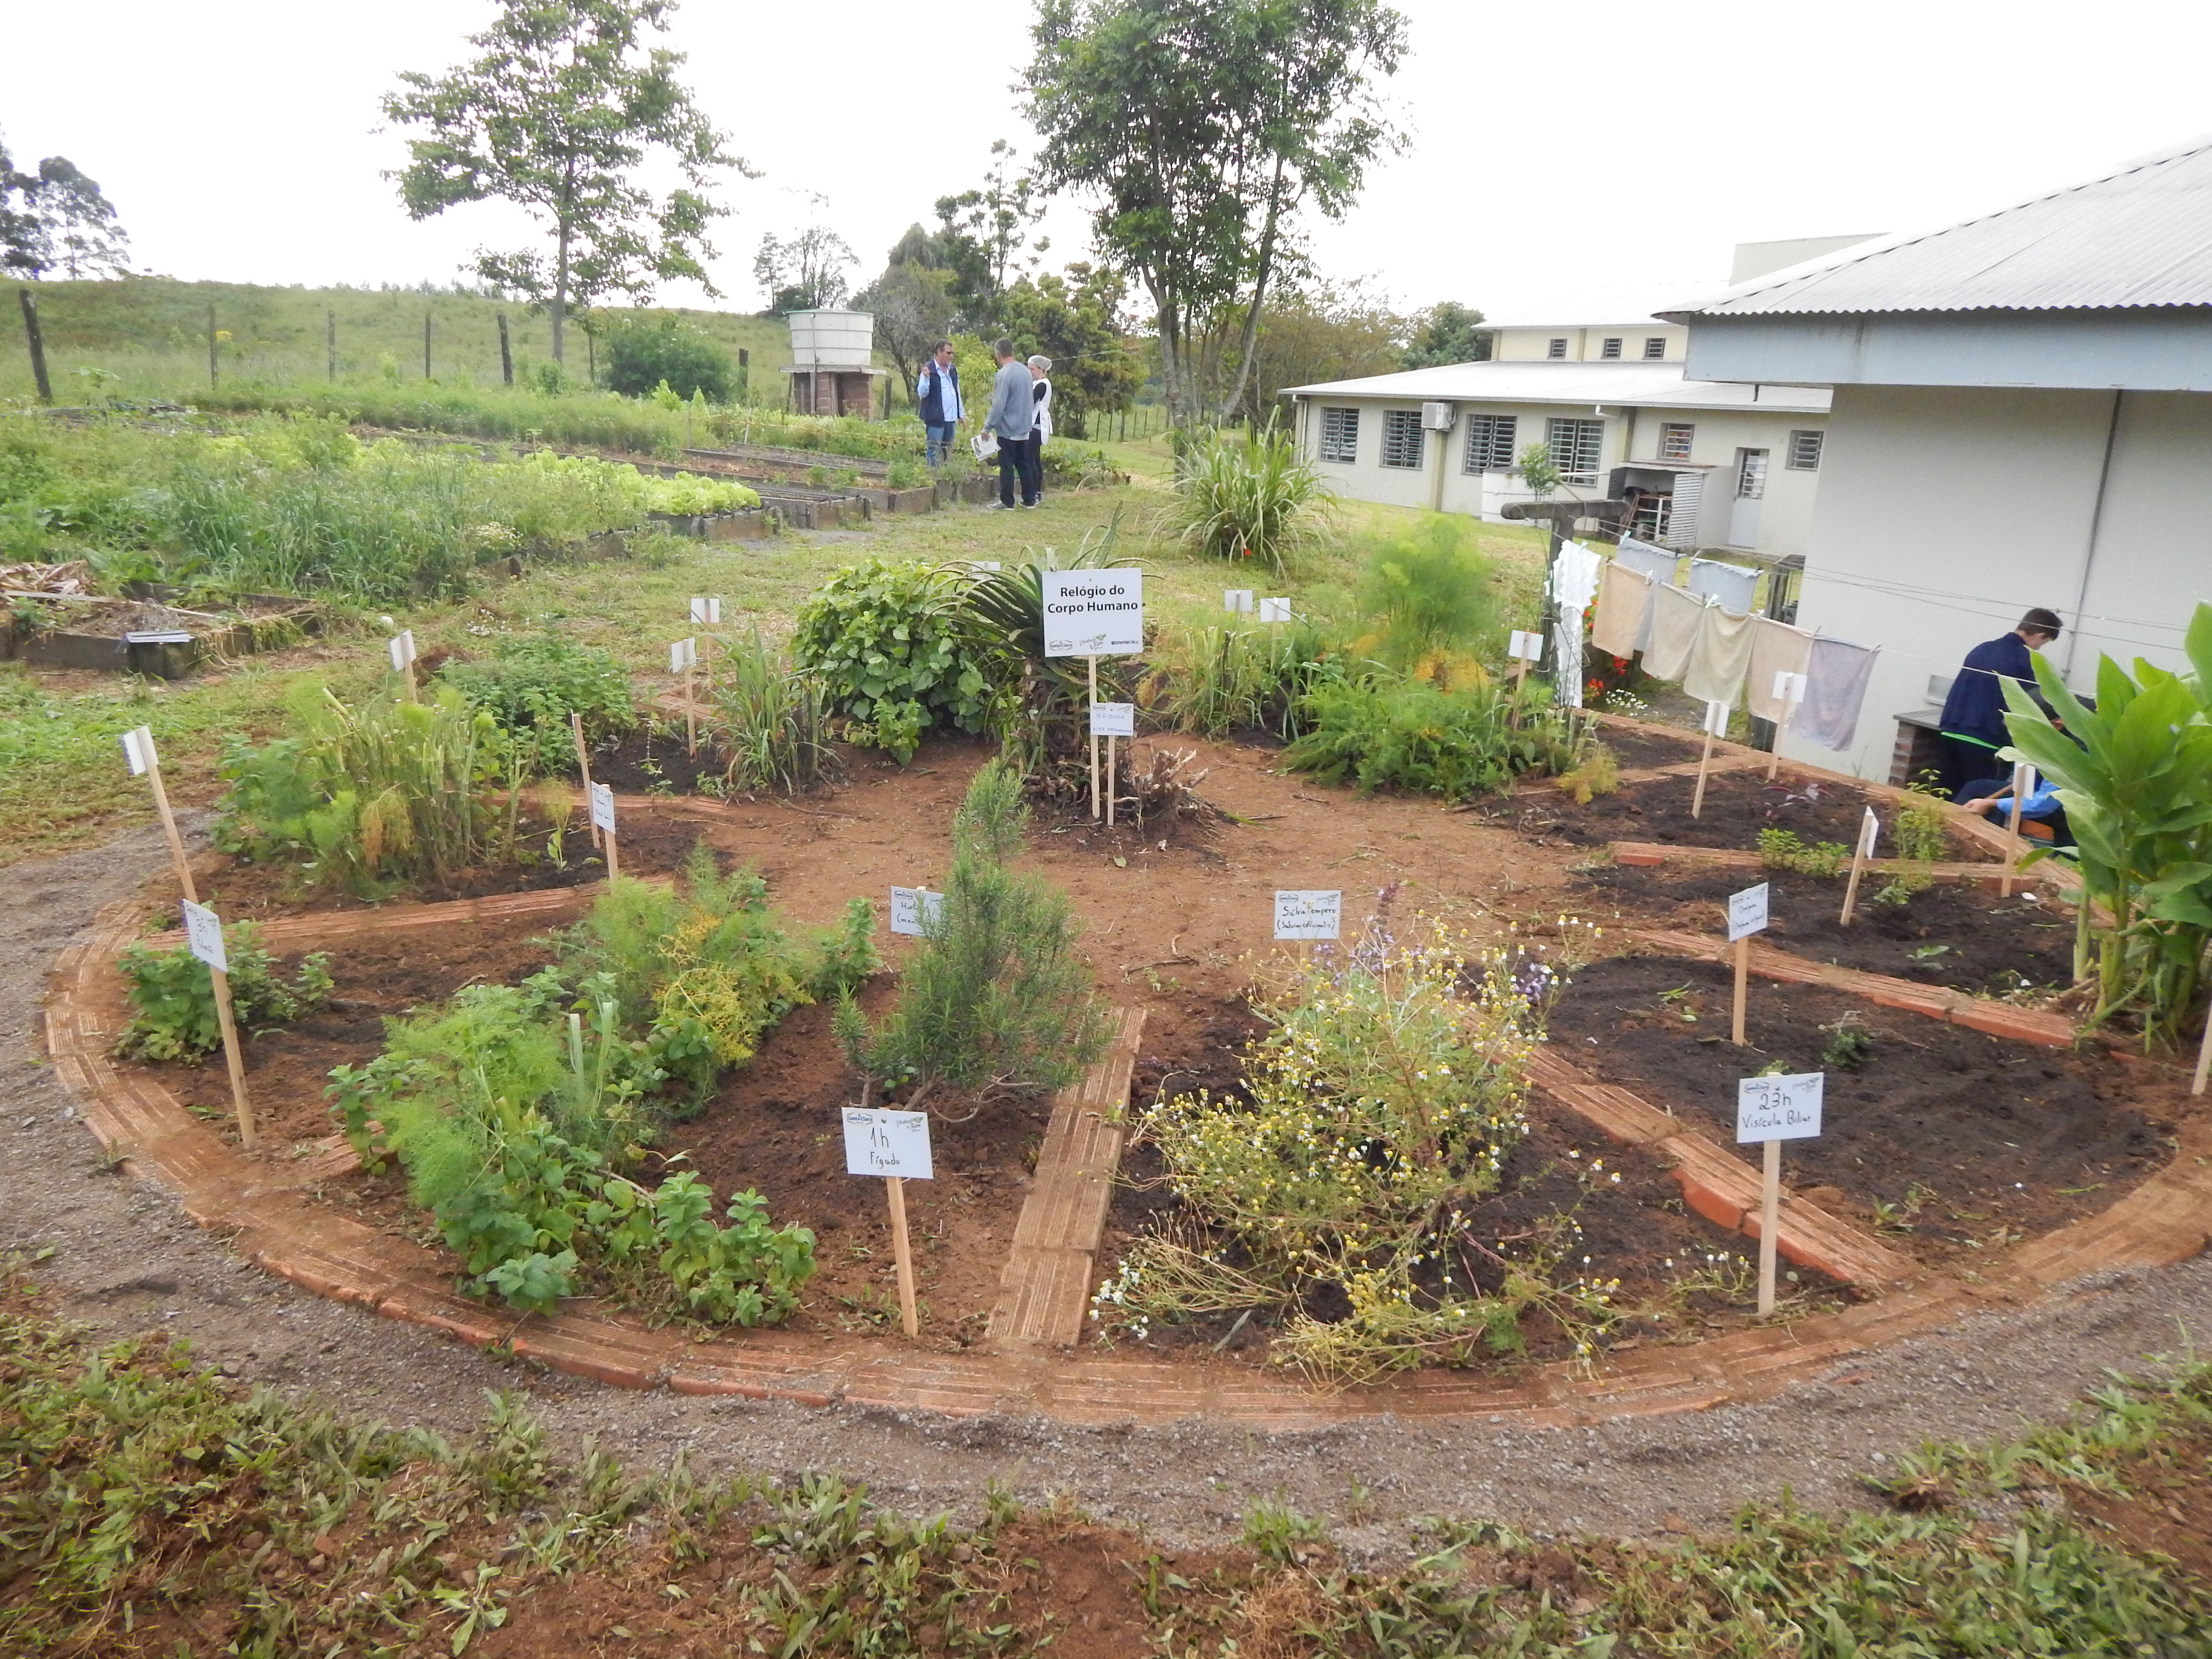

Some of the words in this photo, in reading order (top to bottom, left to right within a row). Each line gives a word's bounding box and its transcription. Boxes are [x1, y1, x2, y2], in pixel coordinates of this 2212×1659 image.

[1060, 585, 1106, 598] Relógio
[1109, 585, 1125, 595] do
[1048, 603, 1084, 614] Corpo
[1087, 601, 1138, 612] Humano
[1759, 1092, 1791, 1110] 23h
[871, 1127, 889, 1148] 1h
[870, 1151, 900, 1169] Fígado
